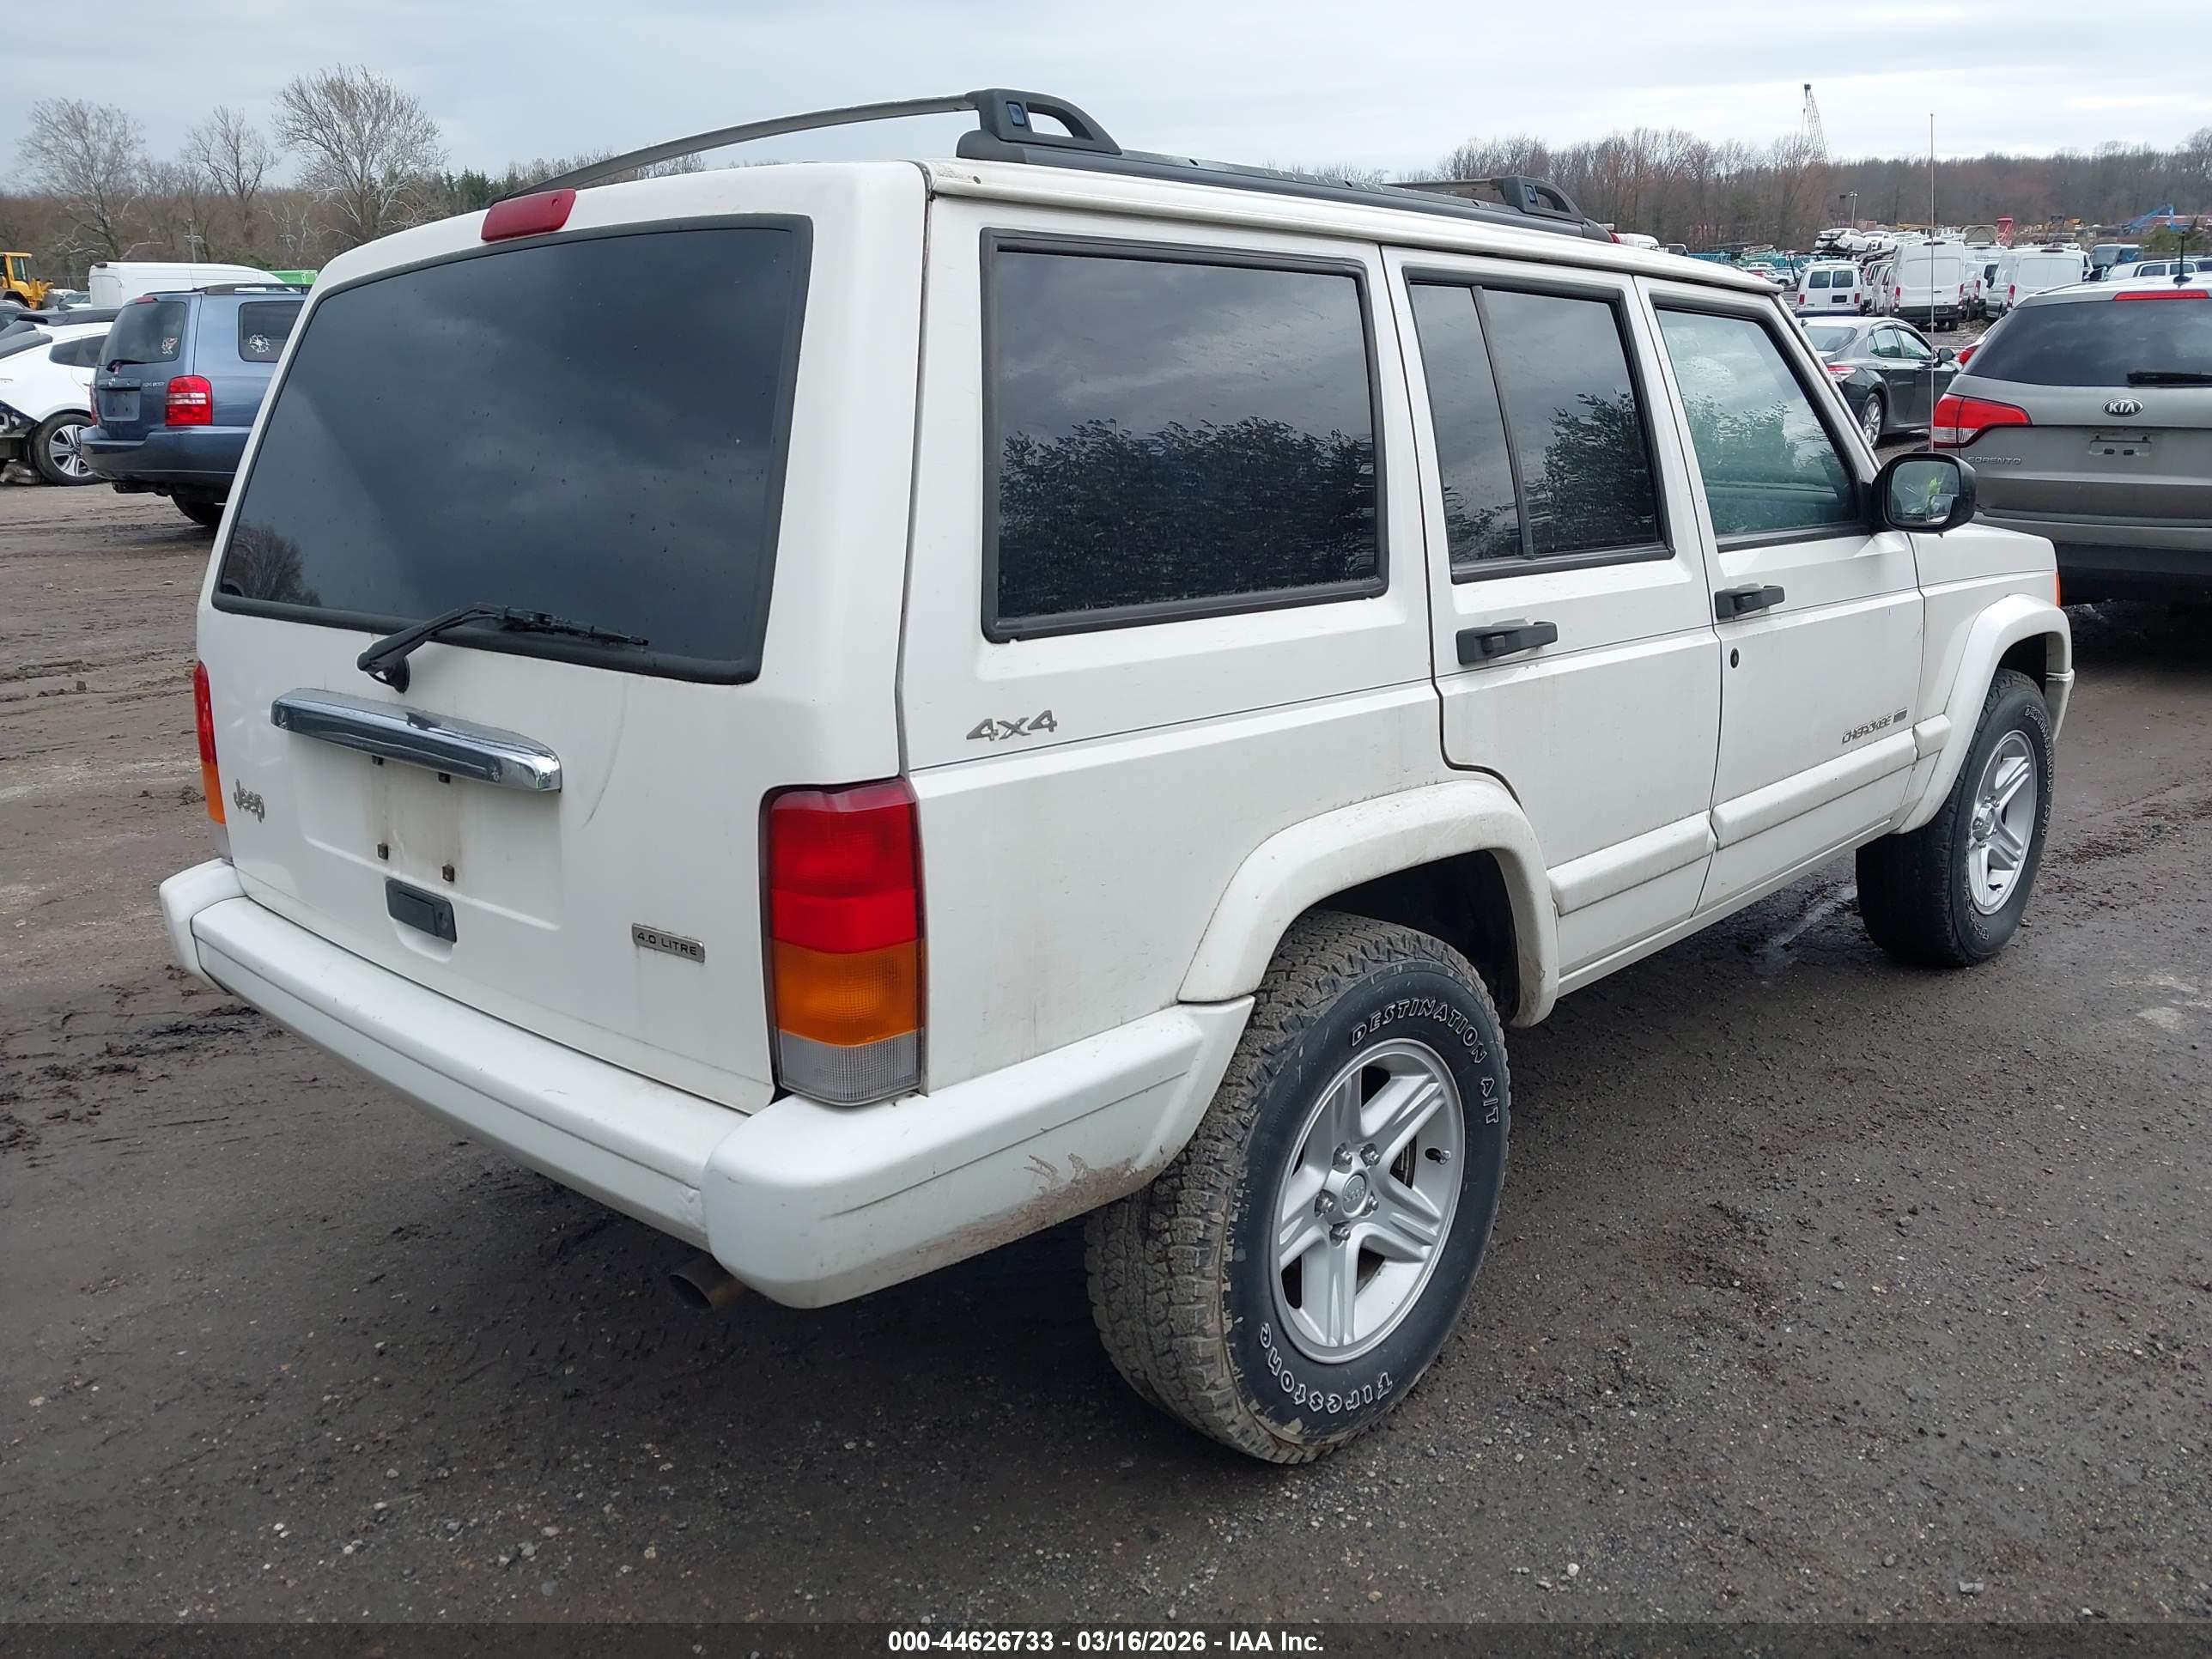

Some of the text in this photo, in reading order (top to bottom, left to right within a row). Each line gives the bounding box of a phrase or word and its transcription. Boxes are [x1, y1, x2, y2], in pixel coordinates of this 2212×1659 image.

[2108, 402, 2136, 413] KIA
[1967, 456, 2021, 465] SORENTO
[1841, 714, 1893, 744] CHEROKEE
[233, 778, 265, 823] Jeep
[637, 932, 697, 956] 4.0 LITRE
[1351, 998, 1488, 1064] DESTINATION
